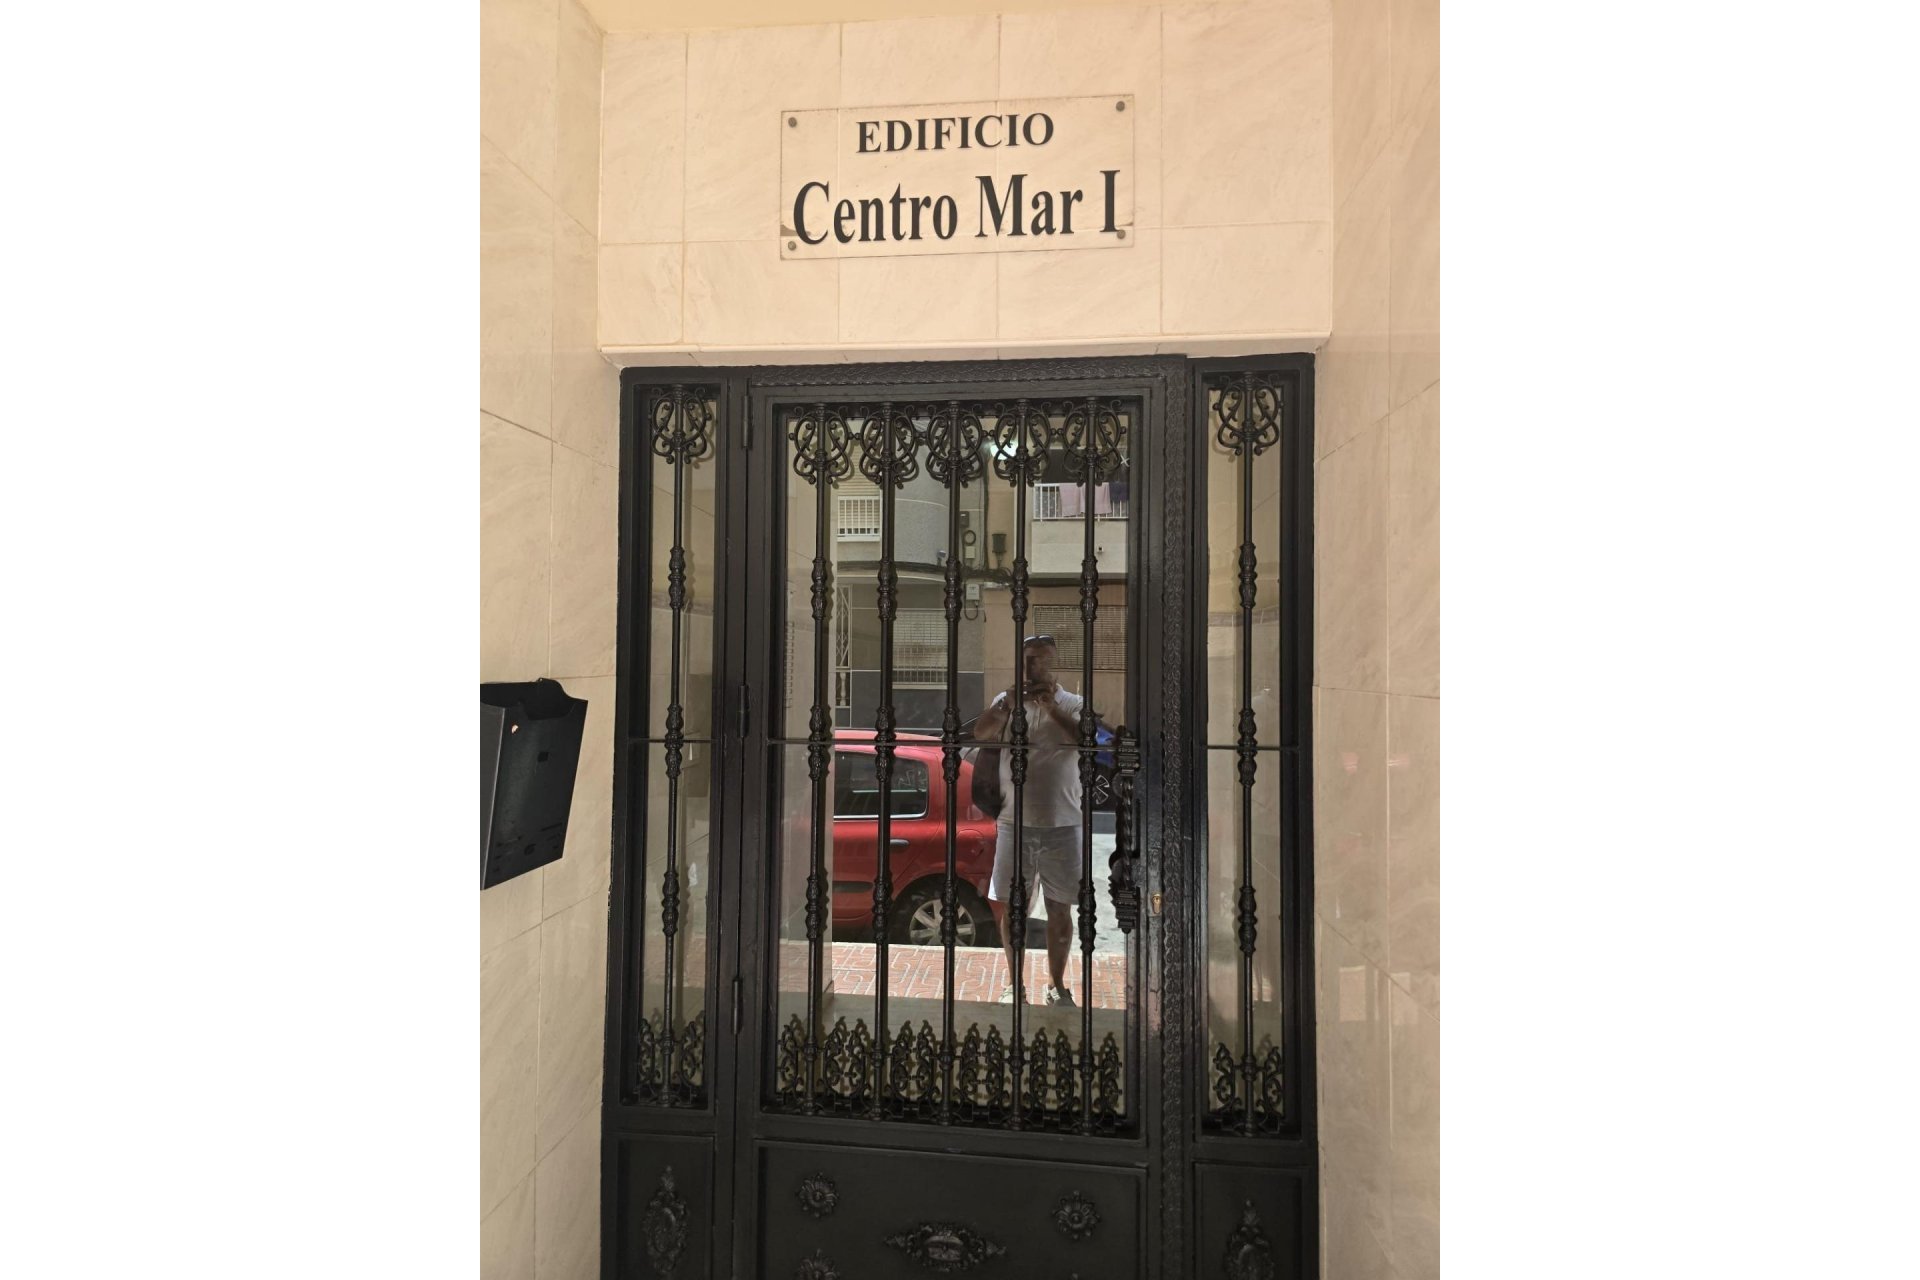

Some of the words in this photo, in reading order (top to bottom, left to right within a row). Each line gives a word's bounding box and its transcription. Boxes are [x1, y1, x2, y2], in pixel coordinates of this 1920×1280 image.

[856, 112, 1054, 153] EDIFICIO
[793, 182, 958, 245] Centro
[975, 173, 1083, 237] Mar
[1100, 169, 1121, 233] I
